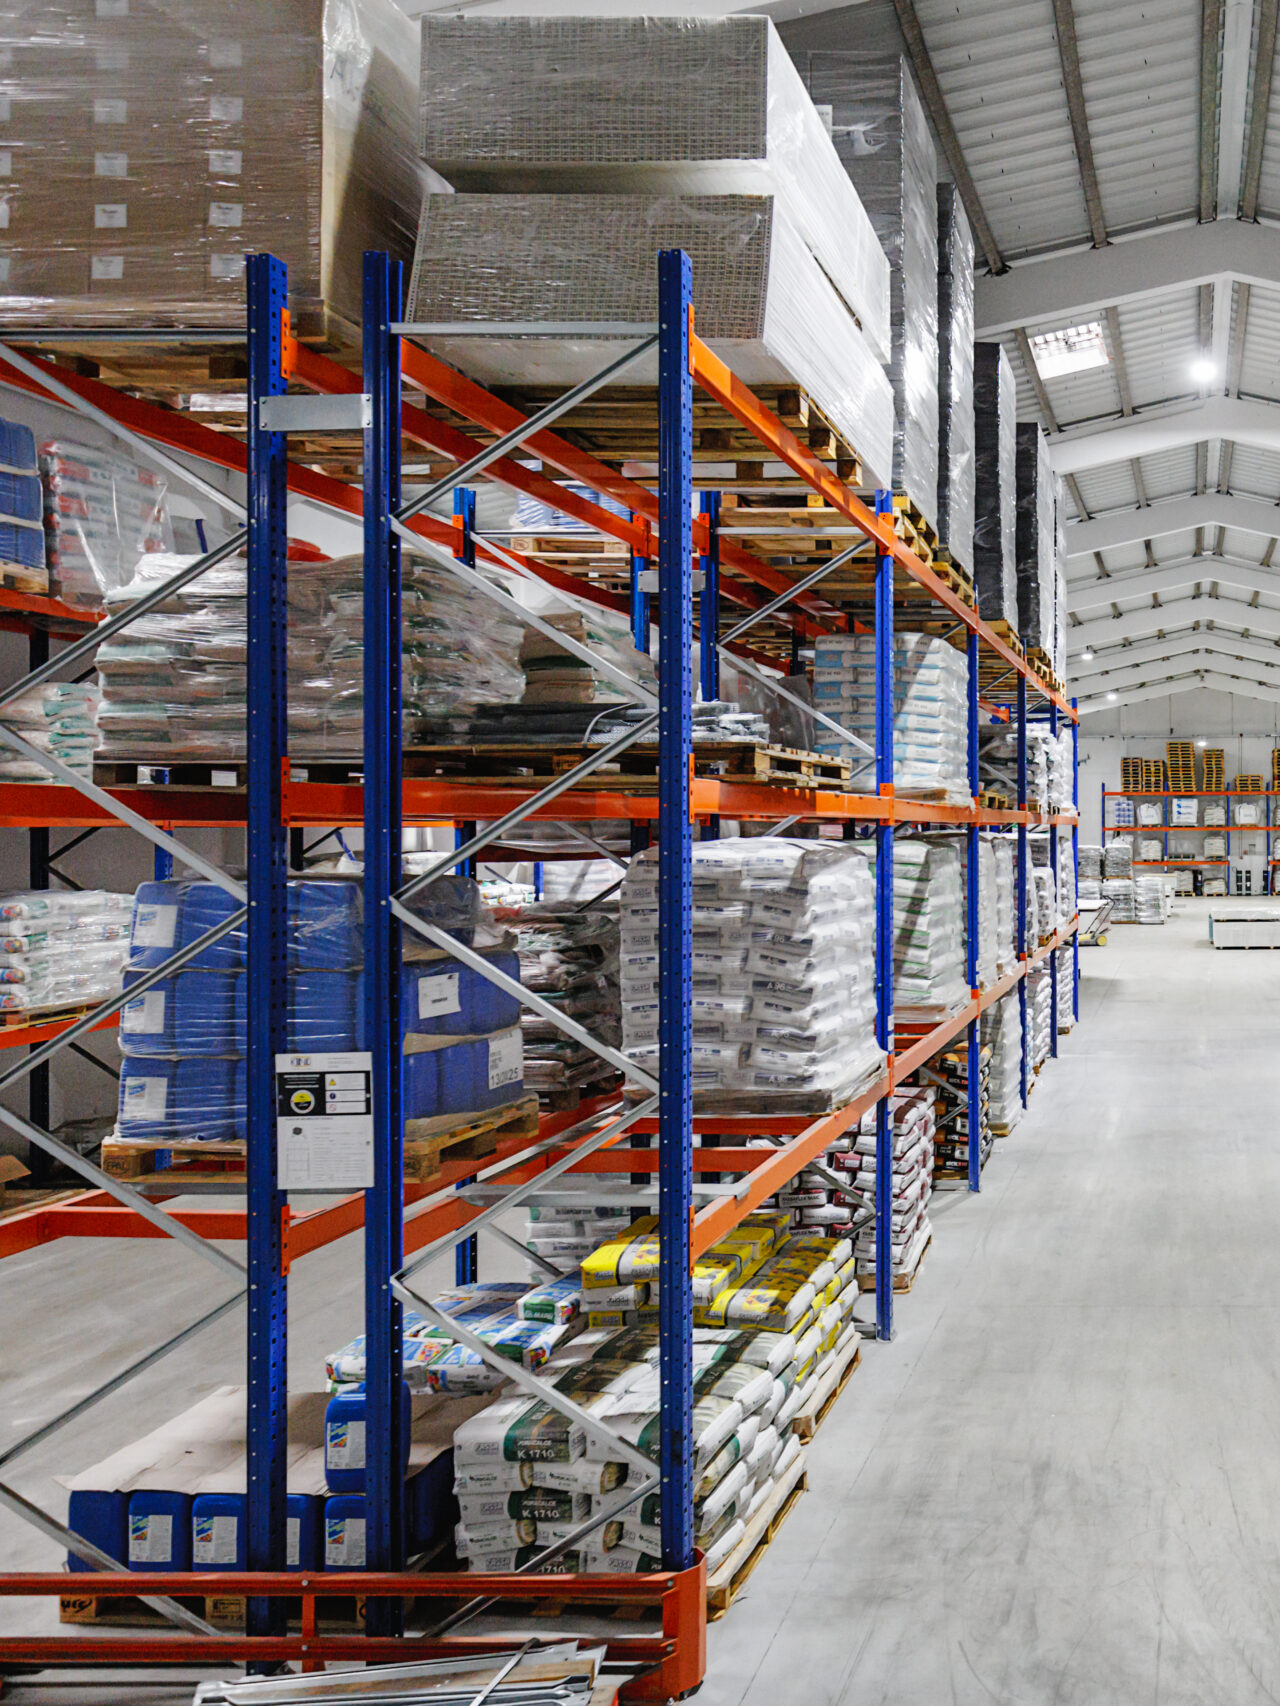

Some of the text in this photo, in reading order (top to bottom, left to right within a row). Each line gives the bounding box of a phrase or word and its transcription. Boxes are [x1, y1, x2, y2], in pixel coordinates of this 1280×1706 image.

[518, 1450, 554, 1459] K 1710
[522, 1510, 560, 1518] K 1710
